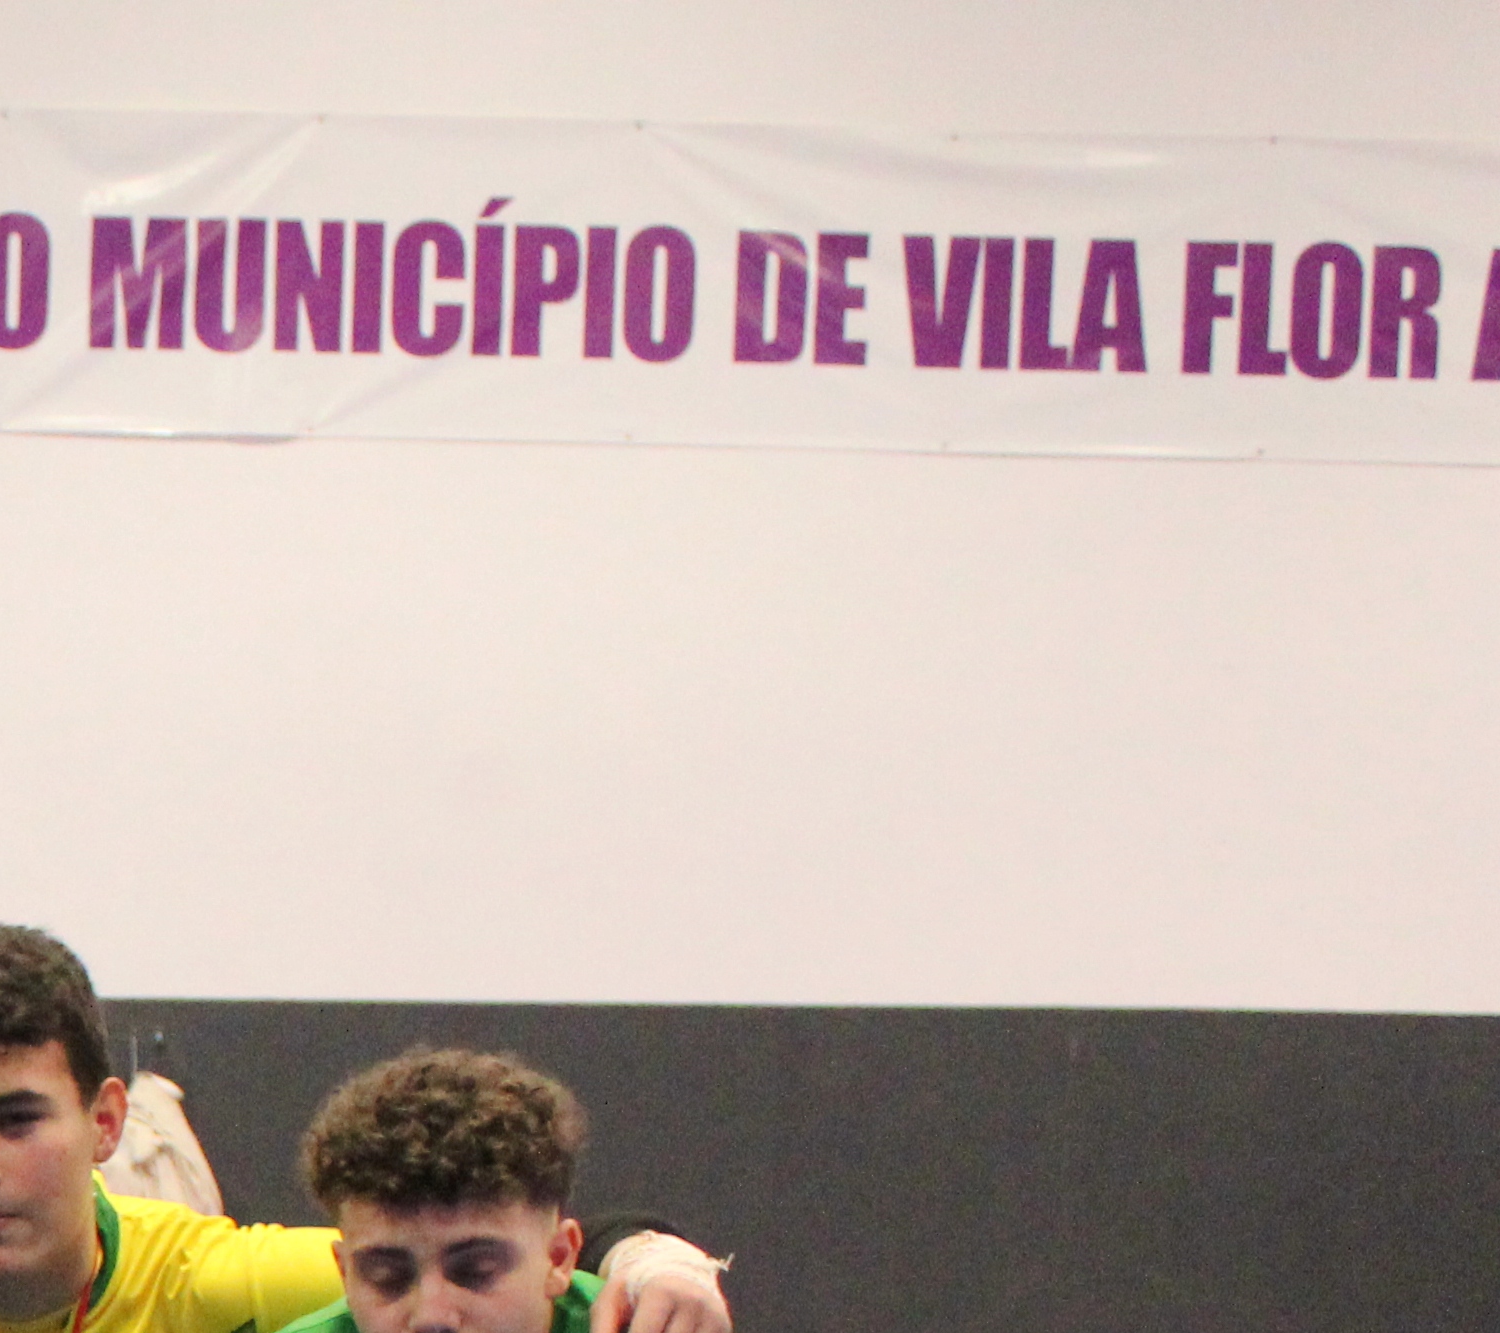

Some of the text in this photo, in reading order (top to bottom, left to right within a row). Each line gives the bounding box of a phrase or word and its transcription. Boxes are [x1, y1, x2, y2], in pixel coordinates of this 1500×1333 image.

[91, 199, 696, 362] MUNICÍPIO
[735, 233, 868, 364] DE
[904, 236, 1146, 373] VILA
[1181, 243, 1440, 379] FLOR
